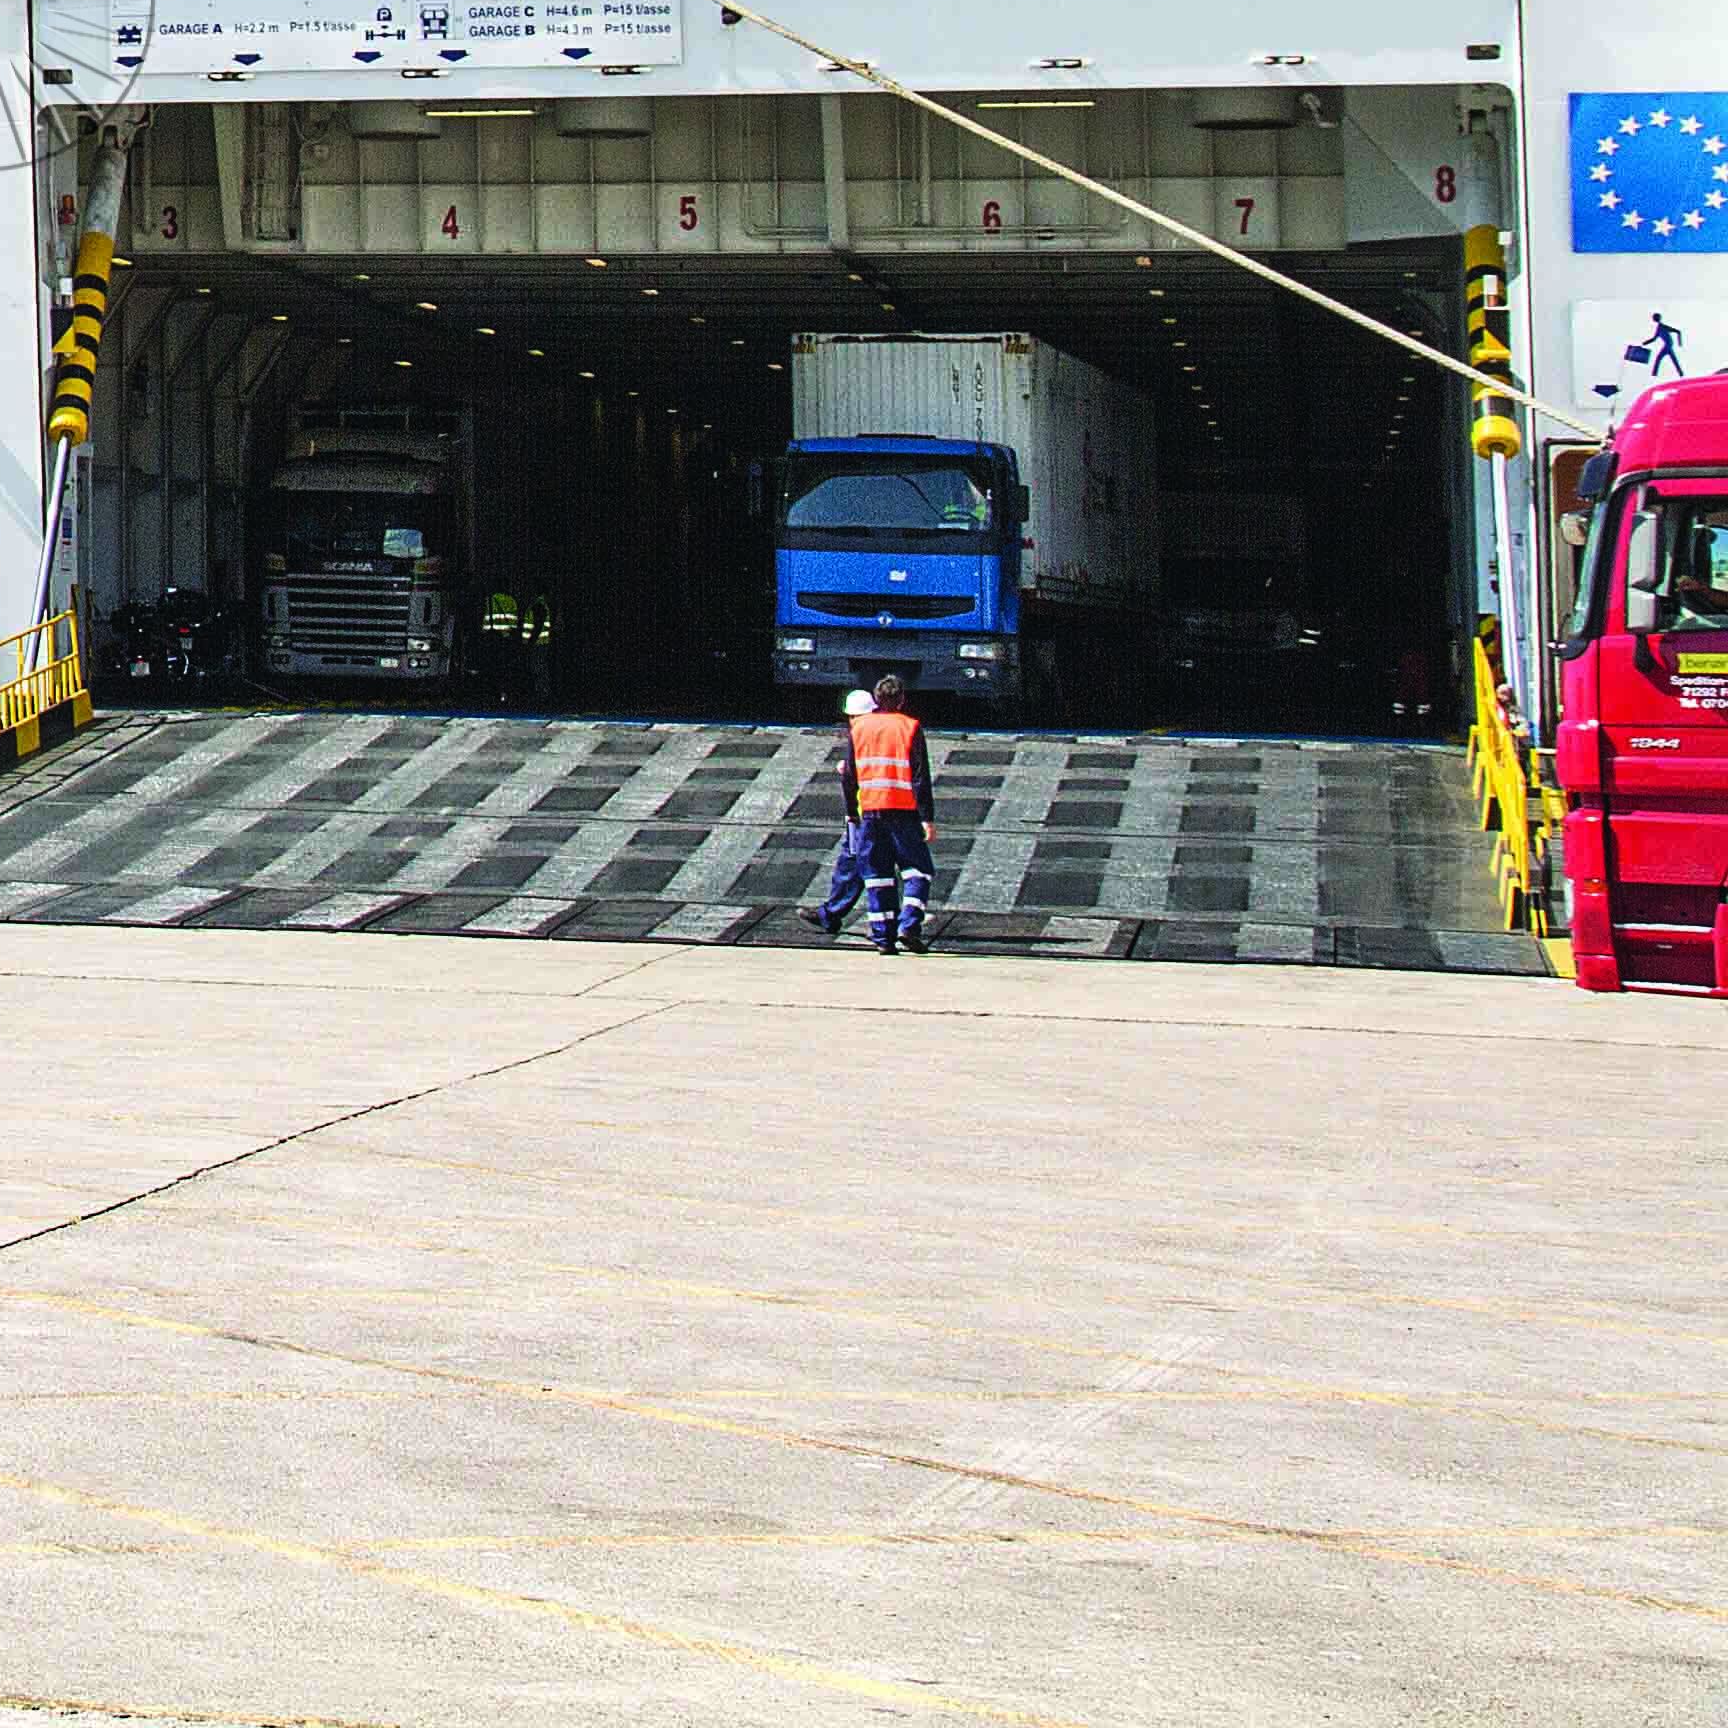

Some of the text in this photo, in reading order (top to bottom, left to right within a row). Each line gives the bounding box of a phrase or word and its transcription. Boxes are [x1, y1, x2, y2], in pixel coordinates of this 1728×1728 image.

[468, 6, 521, 18] GARAGE
[524, 6, 535, 17] C
[581, 8, 592, 16] m
[603, 4, 633, 15] P=15
[635, 4, 671, 15] t/asse
[158, 23, 209, 35] GARAGE
[212, 23, 223, 34] A
[234, 22, 266, 33] H=2.2
[268, 24, 279, 33] m
[468, 25, 521, 37] GARAGE
[524, 25, 535, 36] B
[582, 26, 592, 35] m
[604, 23, 633, 34] P=15
[635, 23, 671, 34] t/asse
[1433, 164, 1456, 204] 8
[161, 206, 178, 239] 3
[442, 204, 460, 240] 4
[678, 195, 697, 232] 5
[981, 200, 1001, 234] 6
[1234, 198, 1254, 234] 7
